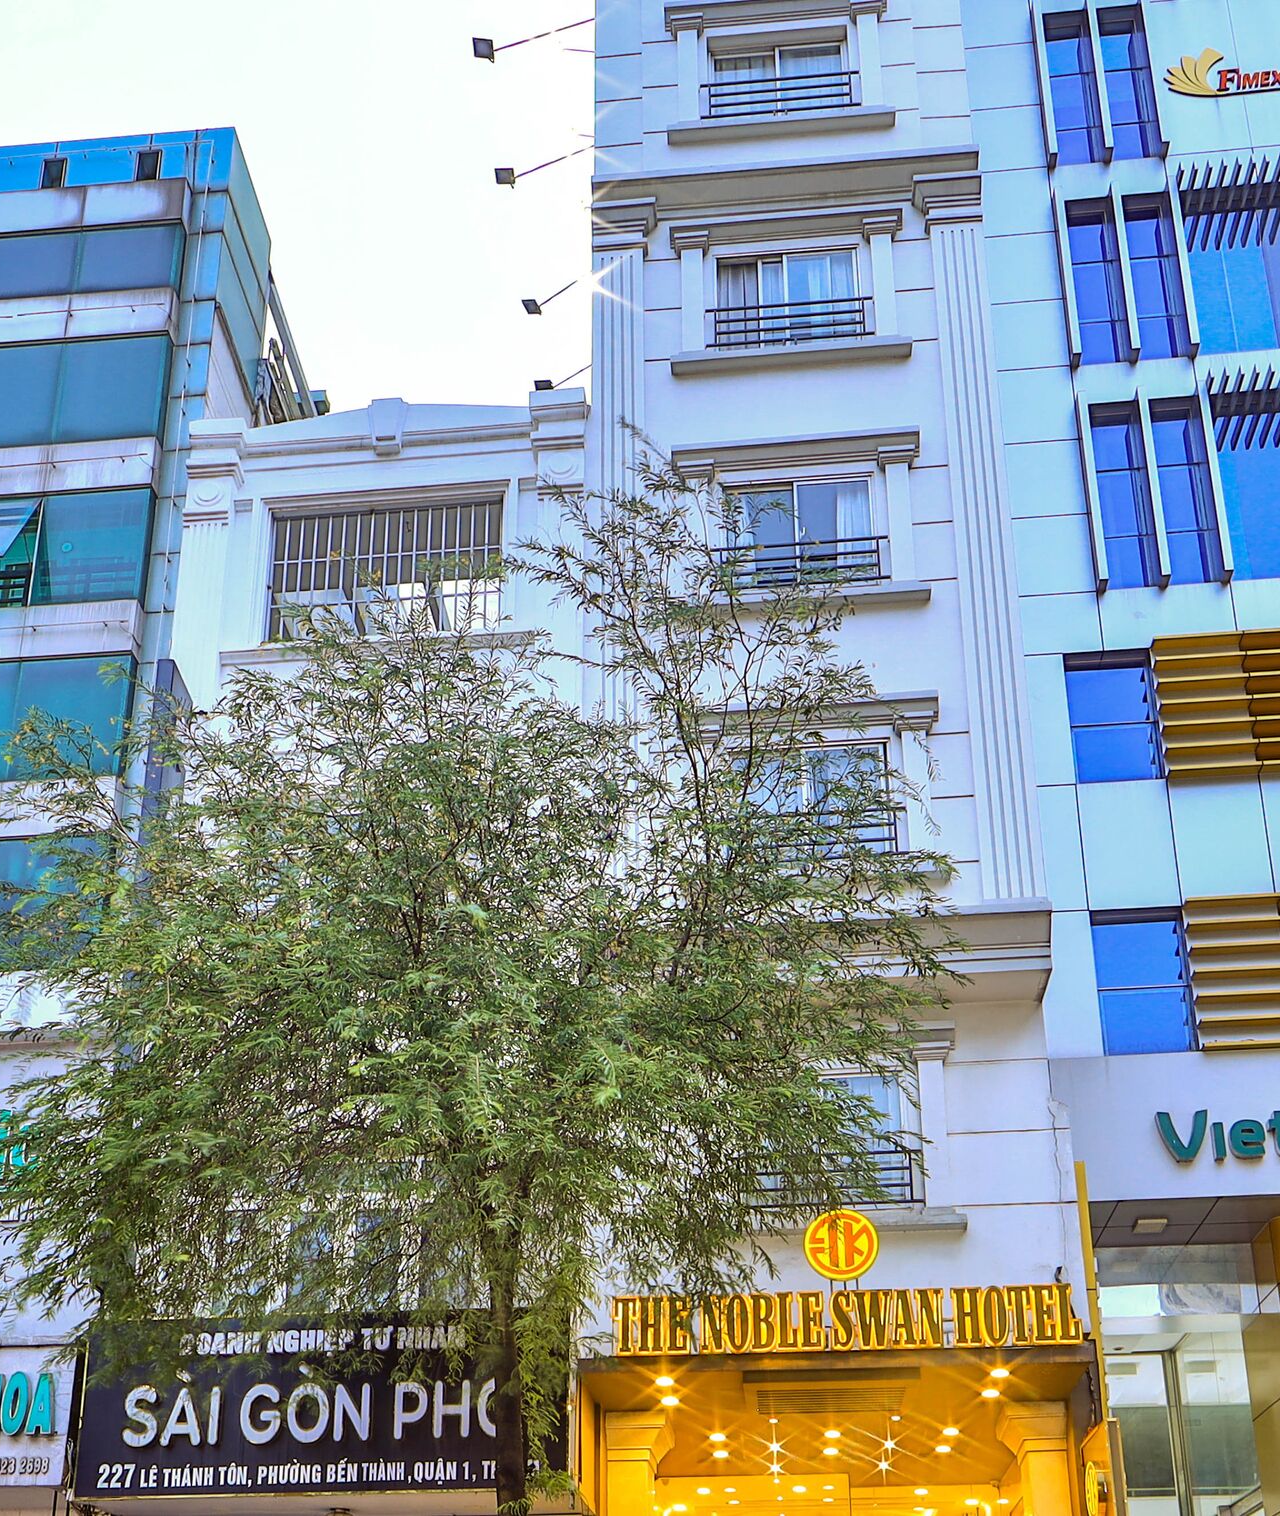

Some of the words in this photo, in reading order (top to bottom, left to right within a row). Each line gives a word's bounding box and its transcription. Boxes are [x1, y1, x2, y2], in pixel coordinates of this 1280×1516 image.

[612, 1296, 693, 1355] THE
[699, 1289, 827, 1354] NOBLE
[829, 1288, 943, 1352] SWAN
[950, 1283, 1084, 1347] HOTEL
[122, 1368, 222, 1448] SÀI
[239, 1360, 372, 1445] GÒN
[96, 1463, 136, 1489] 227
[139, 1464, 158, 1488] LÊ
[163, 1463, 214, 1488] THÁNH
[218, 1462, 253, 1488] TÔN,
[256, 1458, 322, 1485] PHƯỜNG
[326, 1457, 359, 1483] BẾN
